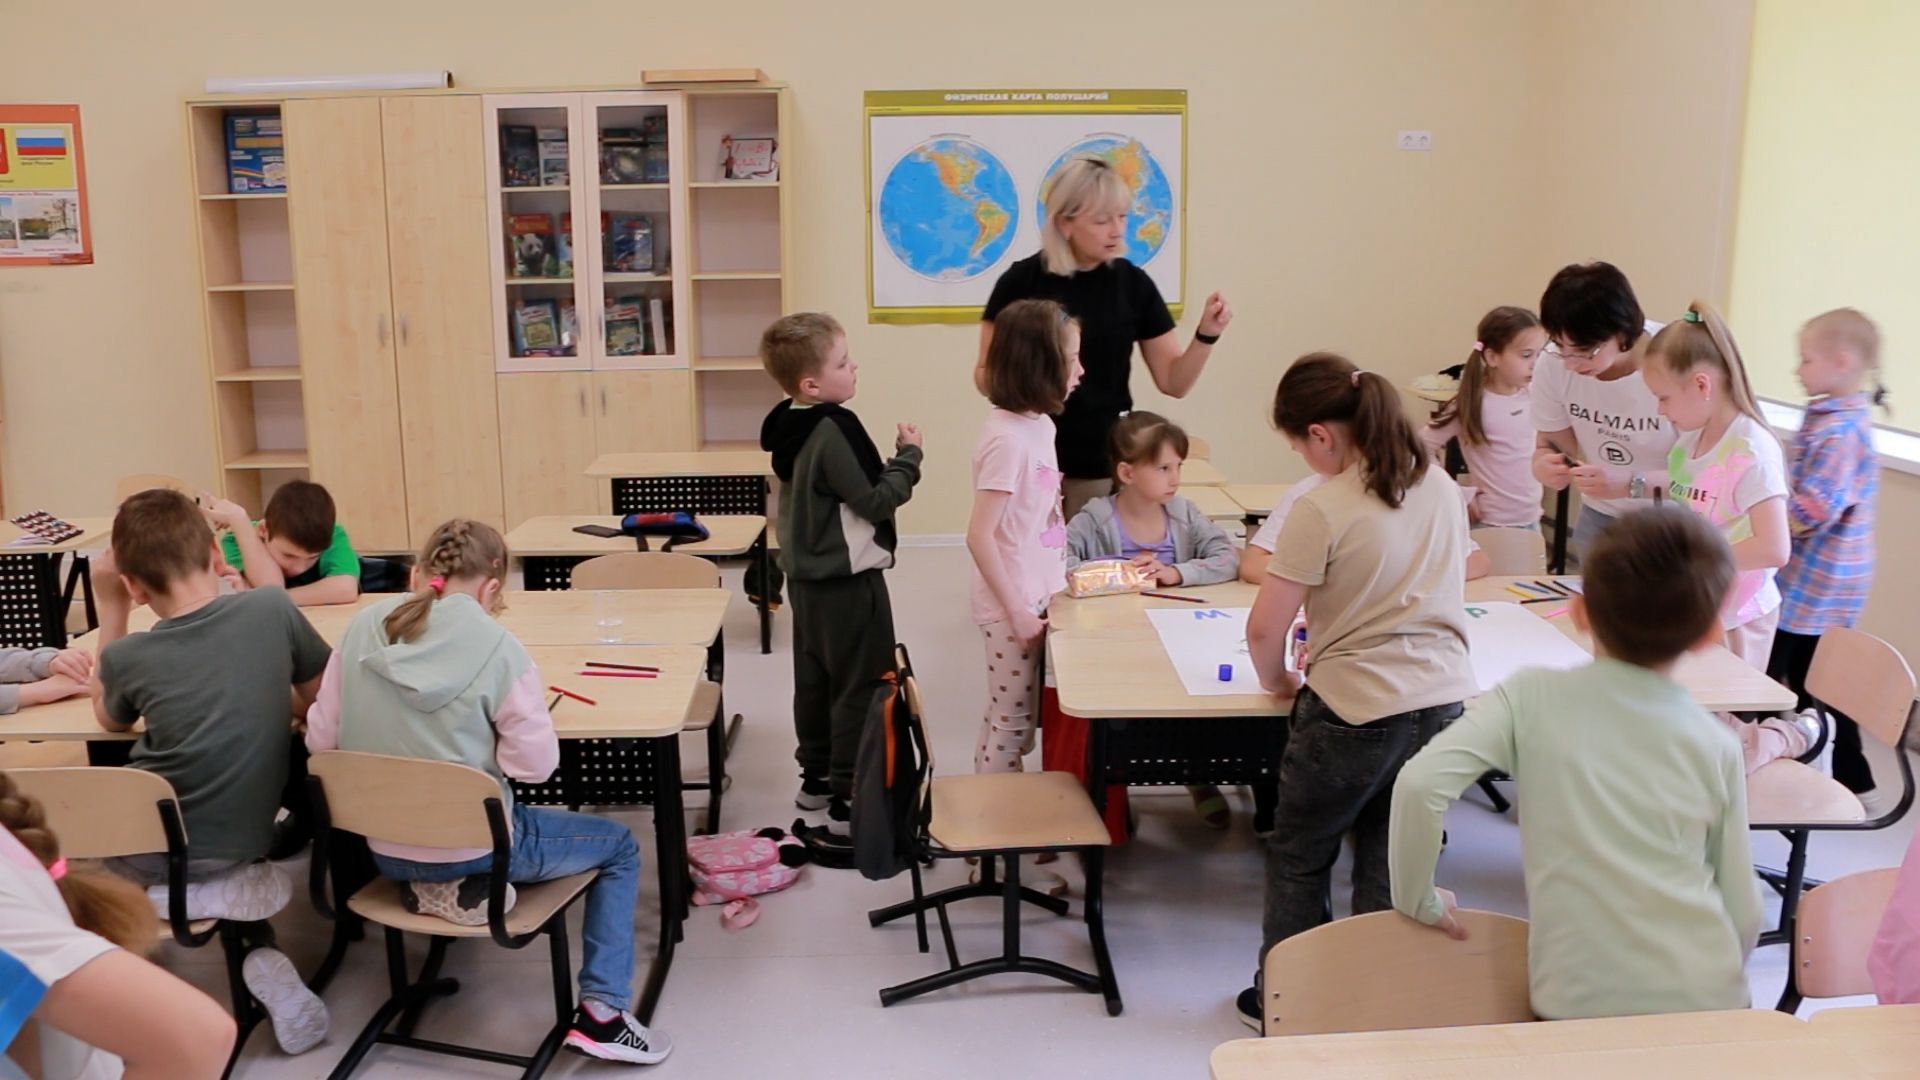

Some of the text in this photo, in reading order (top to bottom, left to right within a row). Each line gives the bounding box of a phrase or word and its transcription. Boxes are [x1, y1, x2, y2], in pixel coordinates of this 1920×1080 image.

[944, 91, 1109, 102] ФИЗИЧЕСКАЯ КАРТА ПОЛУШАРИЙ
[1569, 403, 1660, 431] BALMAIN
[1598, 428, 1630, 442] PARIS
